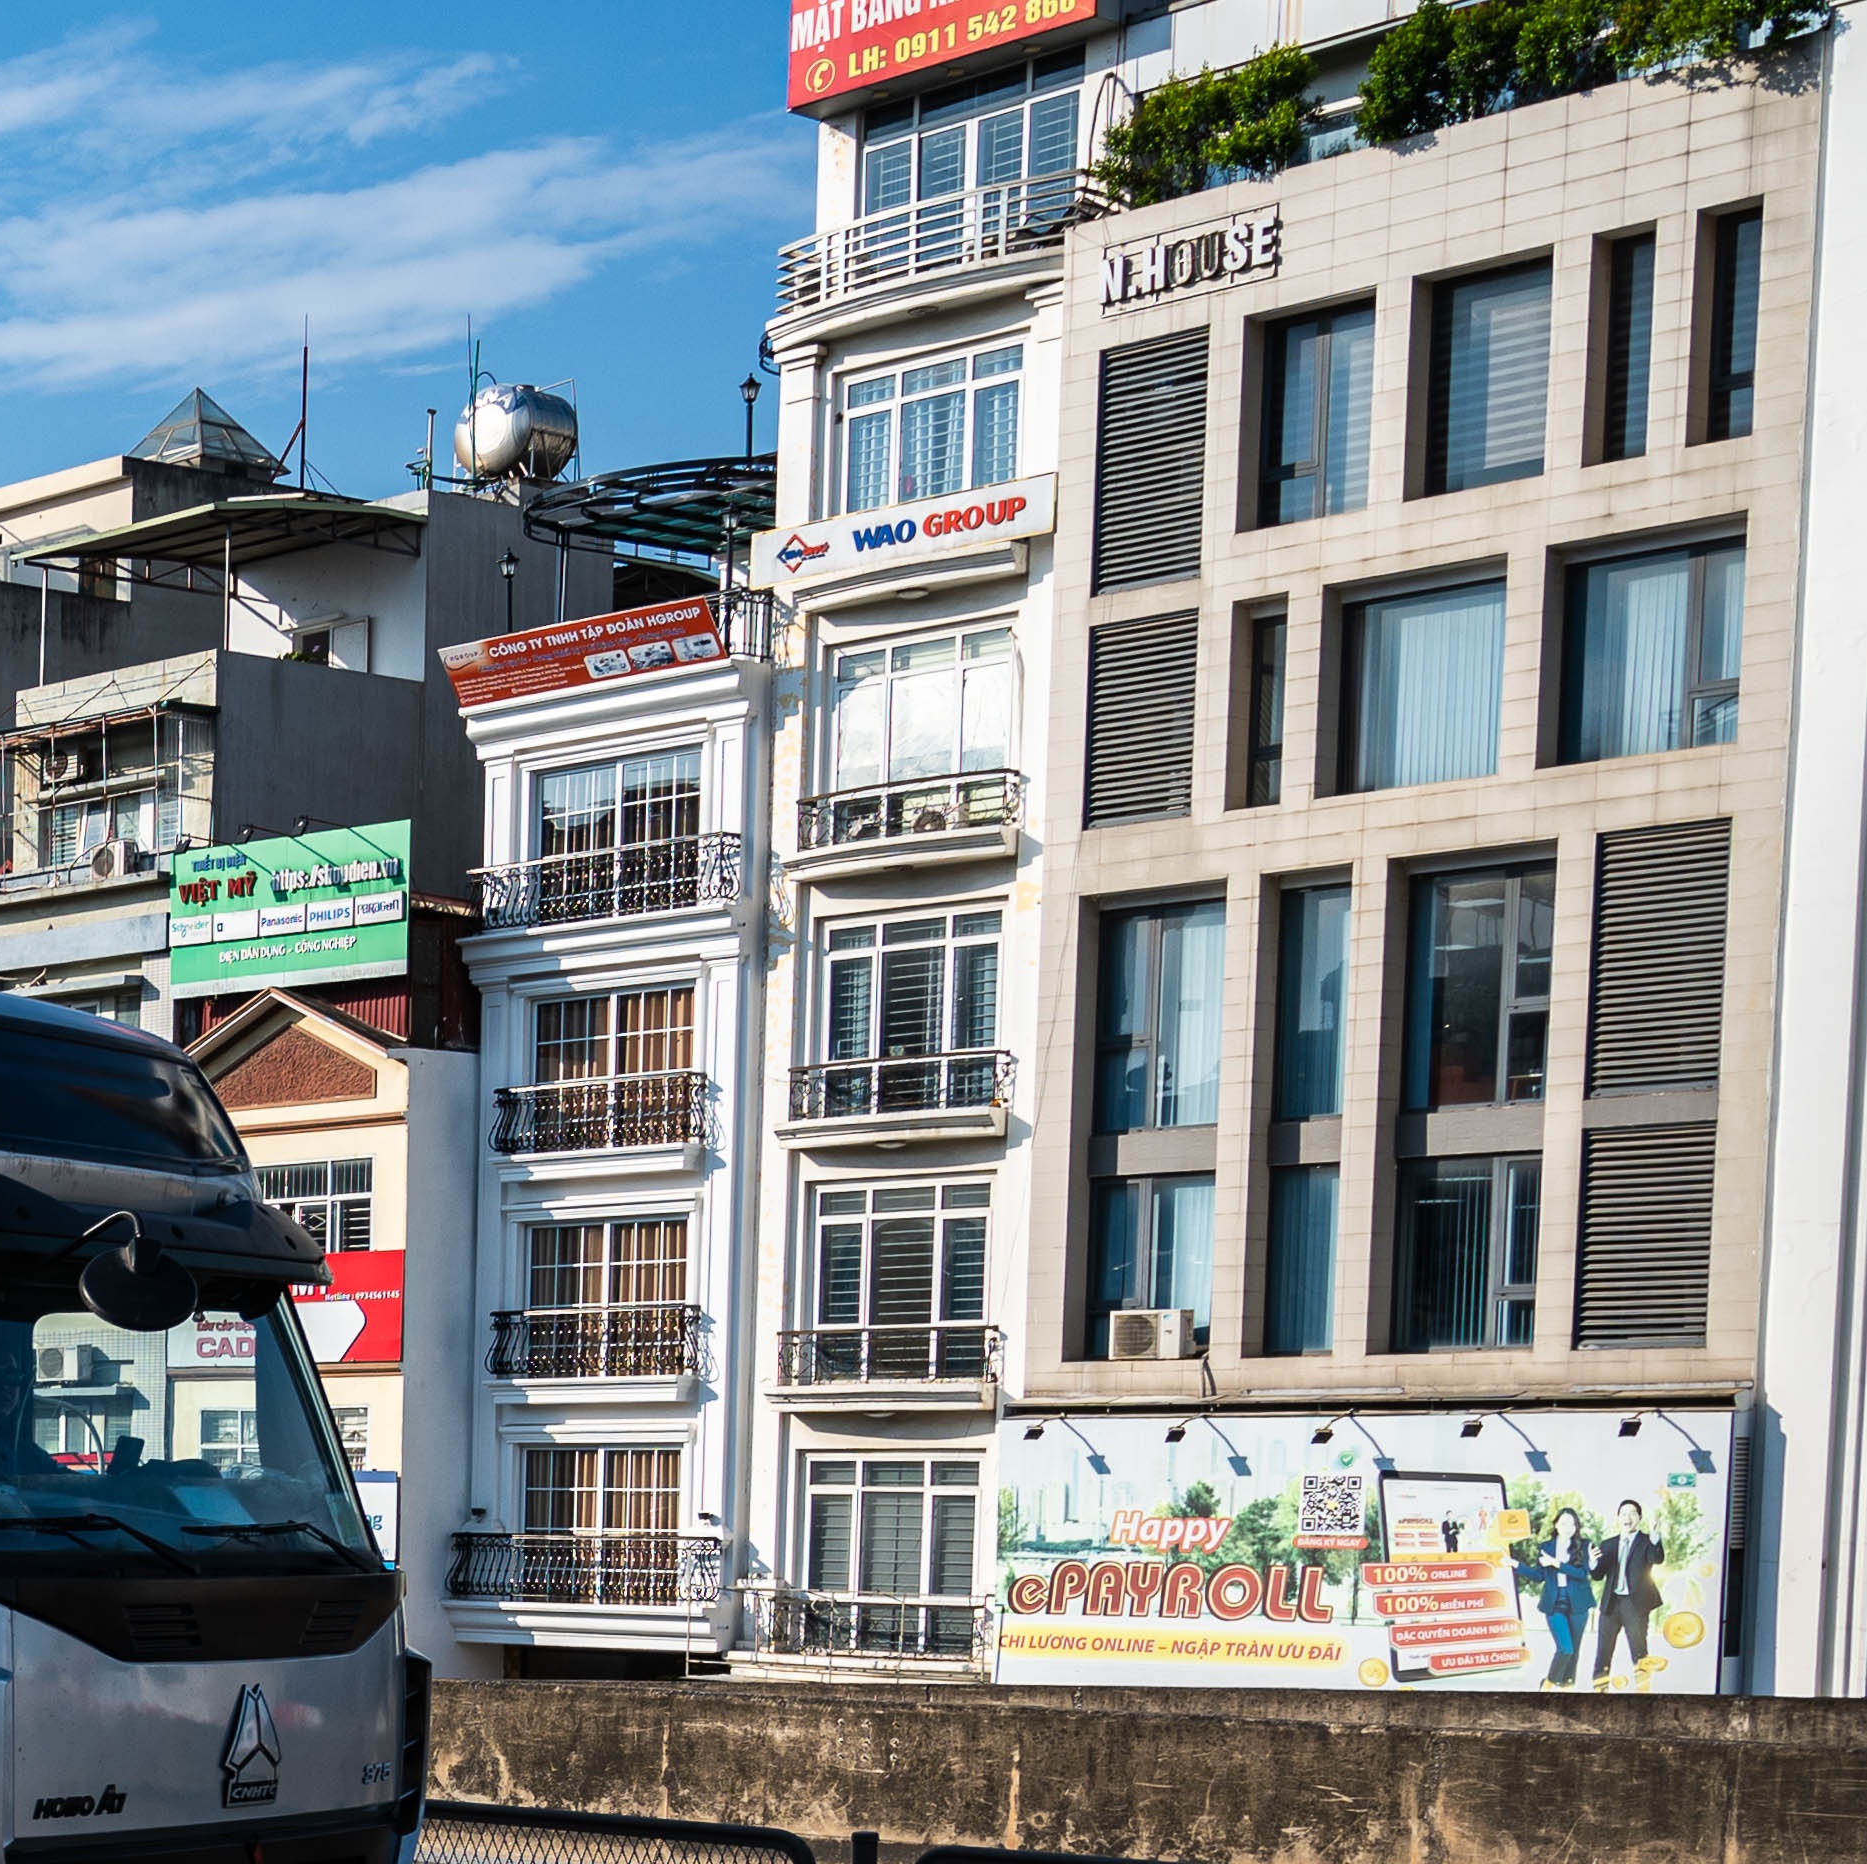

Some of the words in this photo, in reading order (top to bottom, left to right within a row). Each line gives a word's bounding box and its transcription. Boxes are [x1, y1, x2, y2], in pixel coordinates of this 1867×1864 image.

[791, 1, 844, 53] MẶT
[848, 46, 887, 78] LH:
[894, 23, 956, 63] 0911
[967, 5, 1017, 42] 542
[853, 519, 916, 551] WAO
[922, 496, 1026, 538] GROUP
[488, 640, 527, 659] CÔNG
[528, 637, 543, 652] TY
[544, 629, 579, 649] TNHH
[580, 623, 604, 643] TẬP
[606, 616, 646, 637] ĐOÀN
[647, 606, 701, 627] HGROUP
[178, 878, 221, 906] VIỆT
[227, 871, 256, 898] MỸ
[261, 914, 303, 929] Panasonic
[309, 907, 351, 924] PHILIPS
[219, 949, 239, 964] ĐIỆN
[261, 944, 286, 961] DỤNG
[295, 939, 320, 954] CÔNG
[321, 935, 357, 952] NGHIỆP
[1110, 1510, 1230, 1553] Happy
[1336, 1537, 1362, 1548] NGAY
[1374, 1565, 1428, 1583] 100%
[1430, 1568, 1468, 1580] ONLINE
[1009, 1560, 1333, 1622] ePAYROLL
[1384, 1595, 1439, 1613] 100%
[1440, 1598, 1465, 1611] MIỄN
[1467, 1597, 1484, 1608] PHÍ
[1396, 1630, 1416, 1643] ĐẶC
[1417, 1627, 1451, 1641] QUYỀN
[1452, 1624, 1488, 1637] DOANH
[1489, 1622, 1518, 1634] NHÂN
[1028, 1633, 1088, 1651] LƯƠNG
[1091, 1637, 1155, 1654] ONLINE
[1171, 1639, 1223, 1660] NGẬP
[1226, 1639, 1276, 1658] TRÀN
[1278, 1642, 1305, 1660] ƯU
[1308, 1643, 1342, 1661] ĐÃI
[1441, 1657, 1456, 1668] ƯU
[232, 1783, 279, 1799] CNHTC
